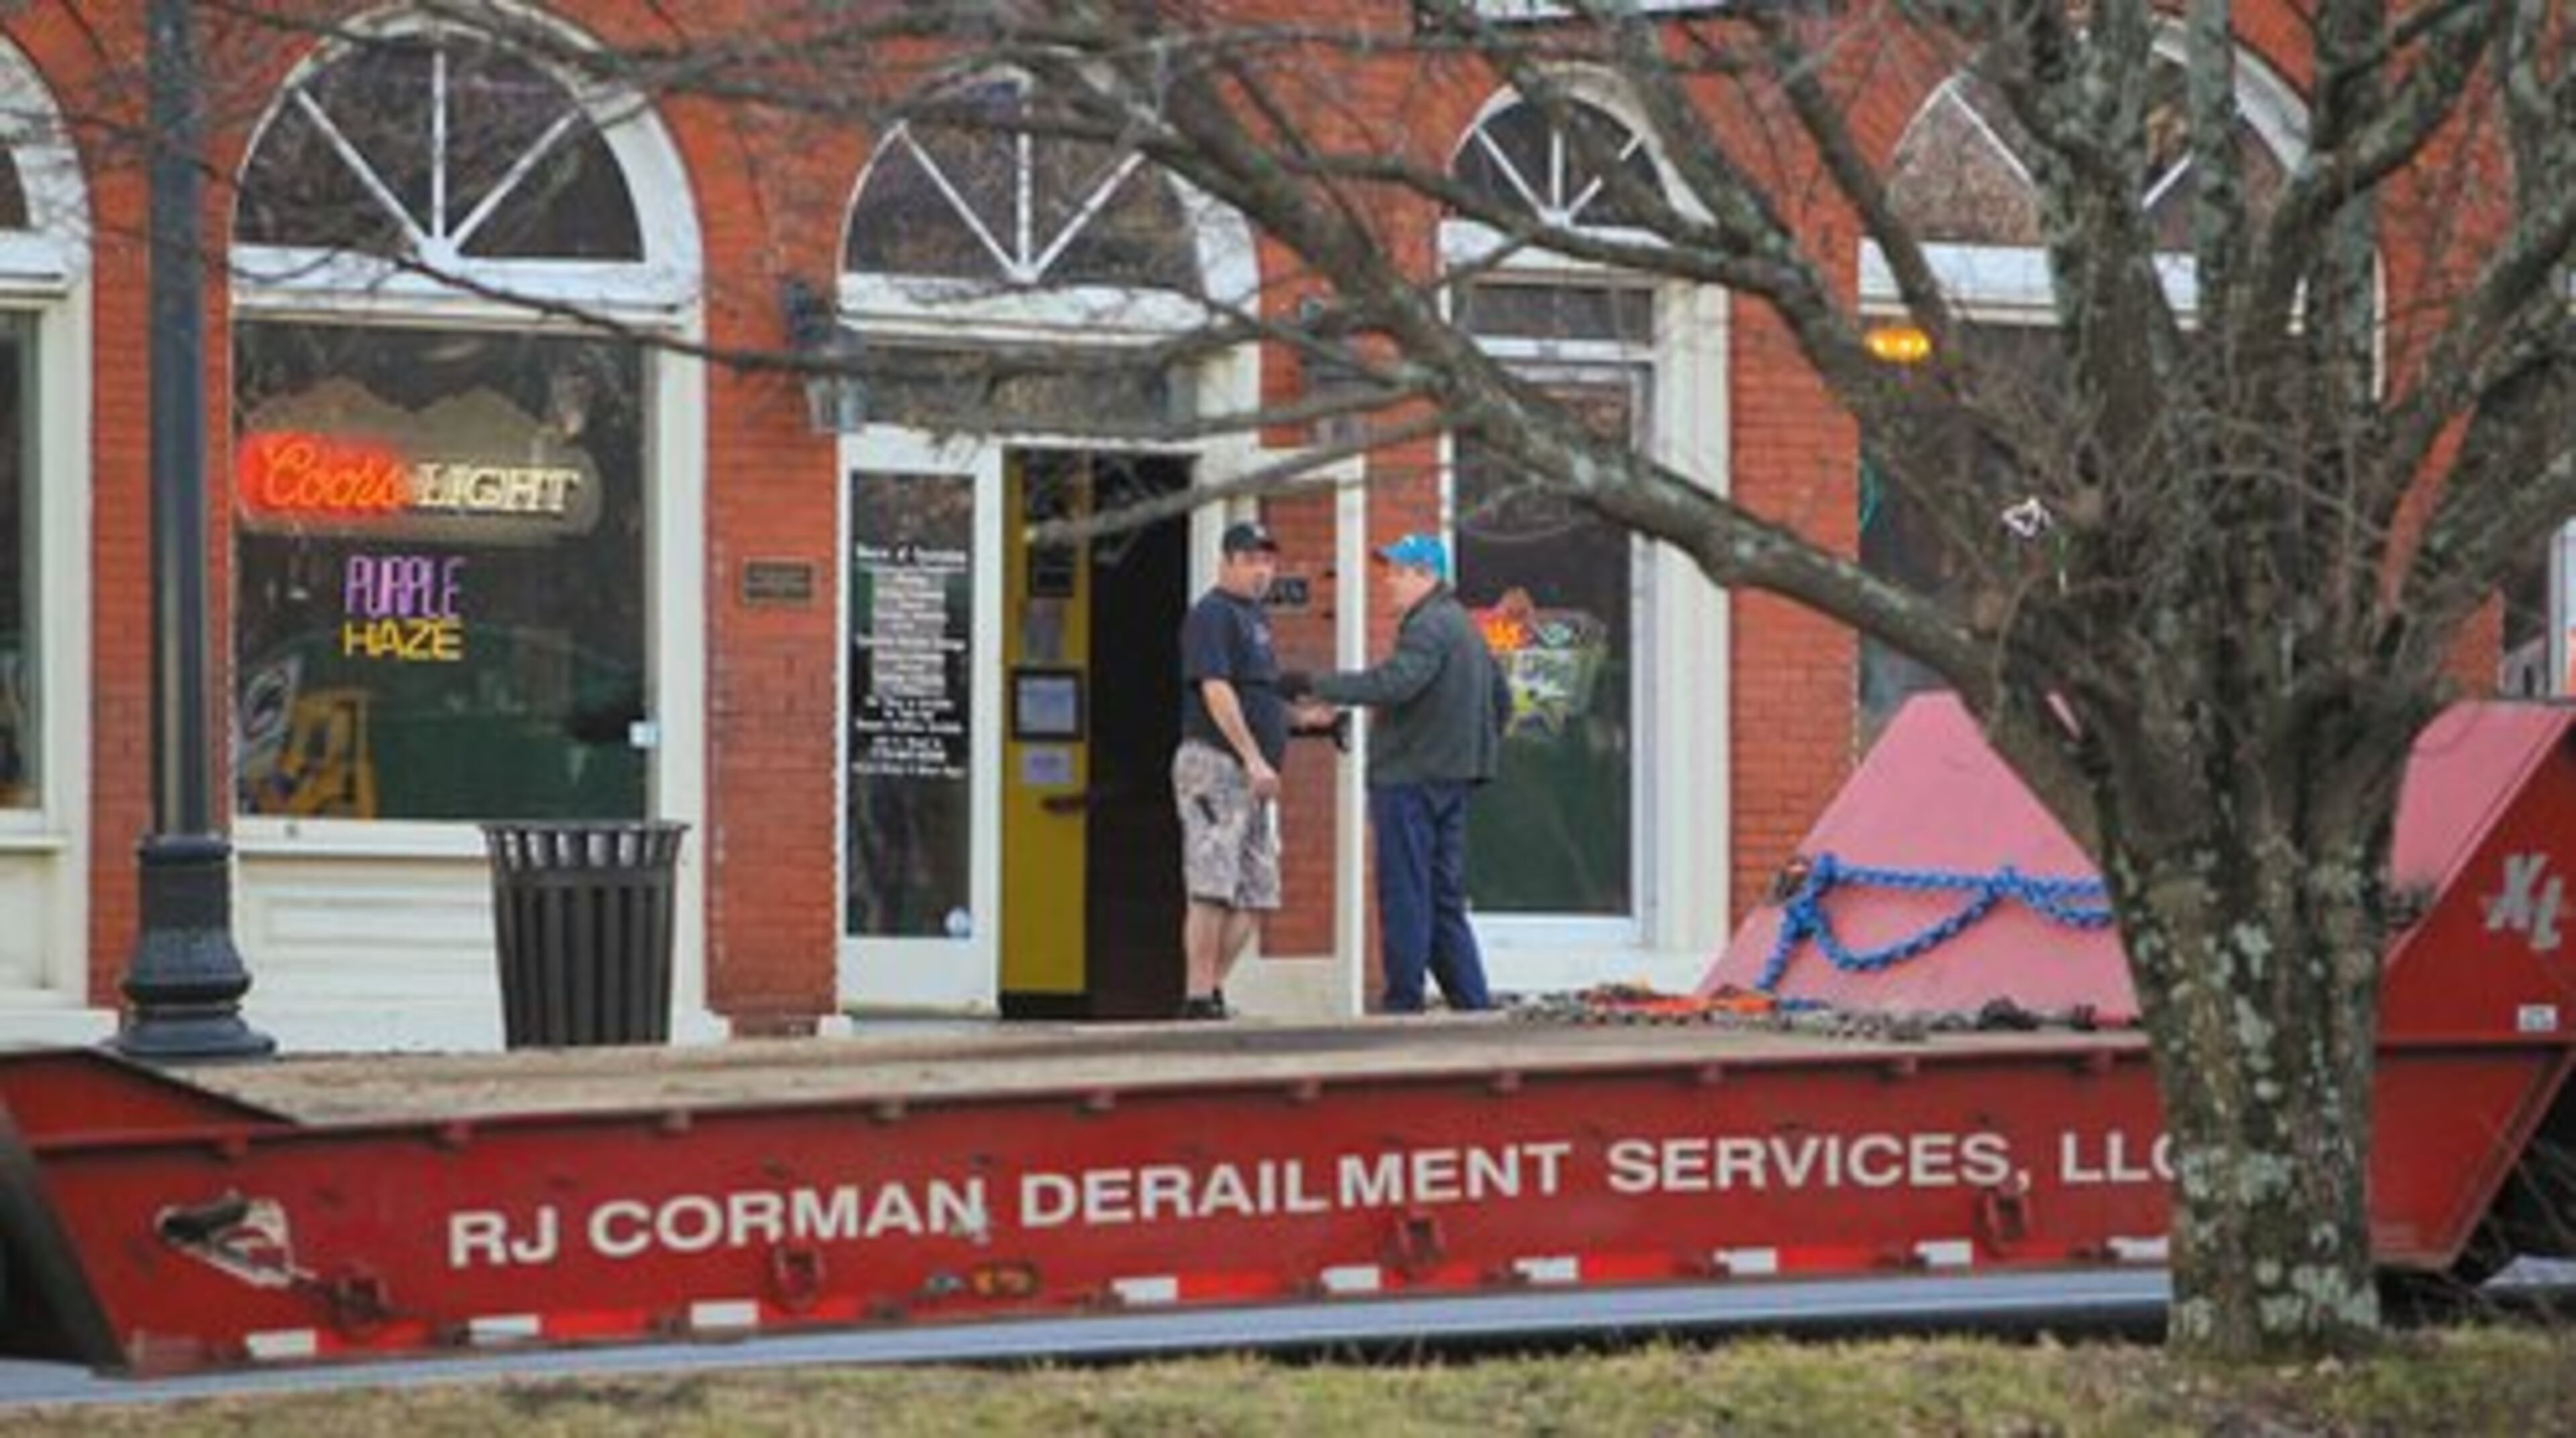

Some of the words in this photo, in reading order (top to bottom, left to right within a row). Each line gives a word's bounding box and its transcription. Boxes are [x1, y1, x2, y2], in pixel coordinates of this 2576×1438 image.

[416, 462, 581, 512] LIGHT
[345, 554, 467, 619] PURPLE
[343, 618, 464, 661] HAZE
[449, 1206, 559, 1269] RJ
[587, 1177, 987, 1258] CORMAN
[1020, 1142, 1571, 1229] DERAILMENT
[1607, 1132, 2031, 1193] SERVICES,
